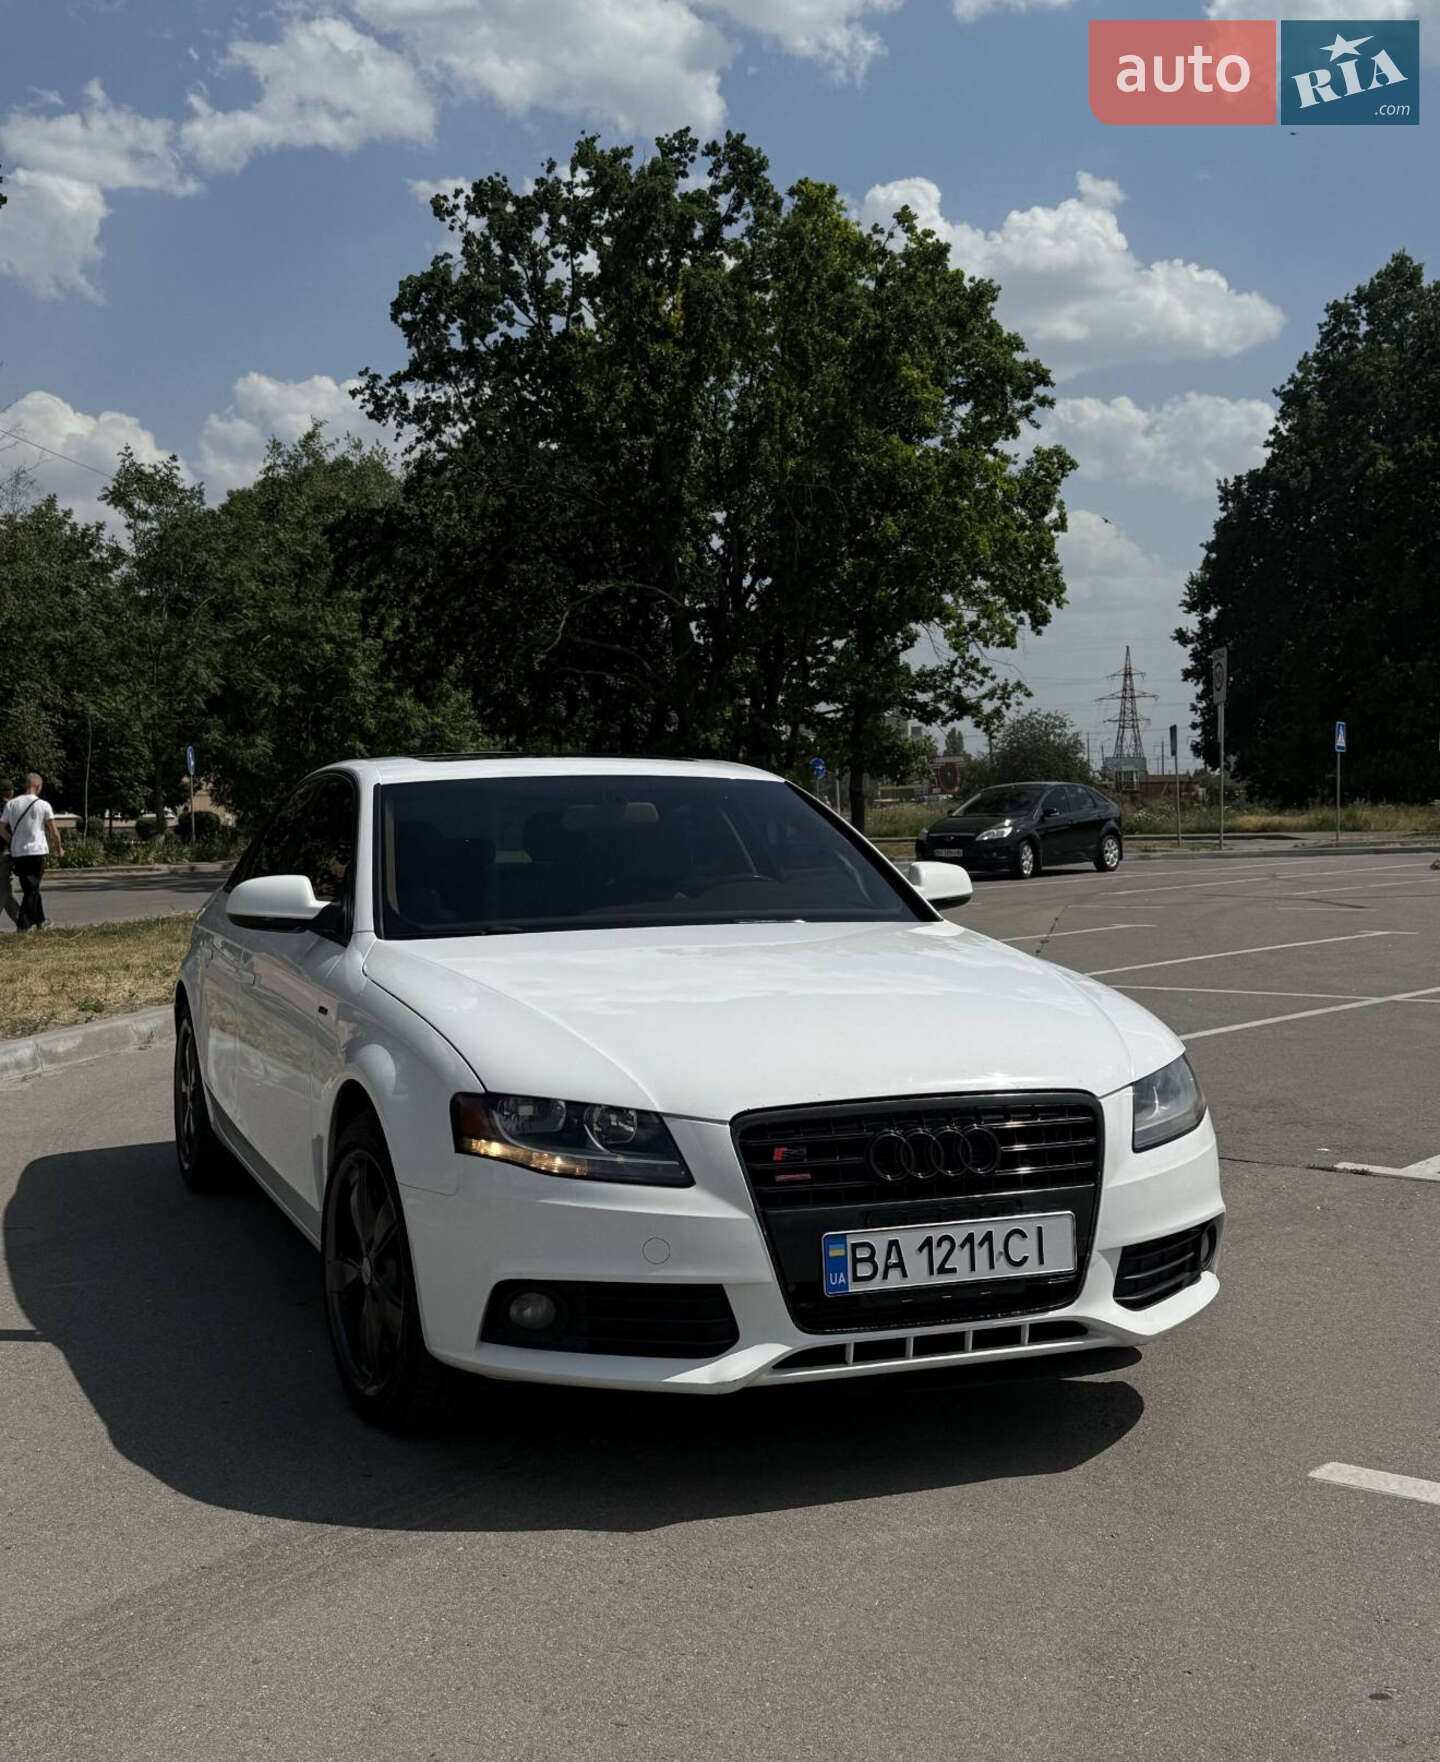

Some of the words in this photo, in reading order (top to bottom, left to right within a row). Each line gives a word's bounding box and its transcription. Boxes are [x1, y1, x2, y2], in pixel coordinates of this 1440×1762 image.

[850, 1238, 908, 1283] BA
[917, 1230, 995, 1277] 1211
[1003, 1225, 1045, 1268] CI
[829, 1272, 847, 1286] UA
